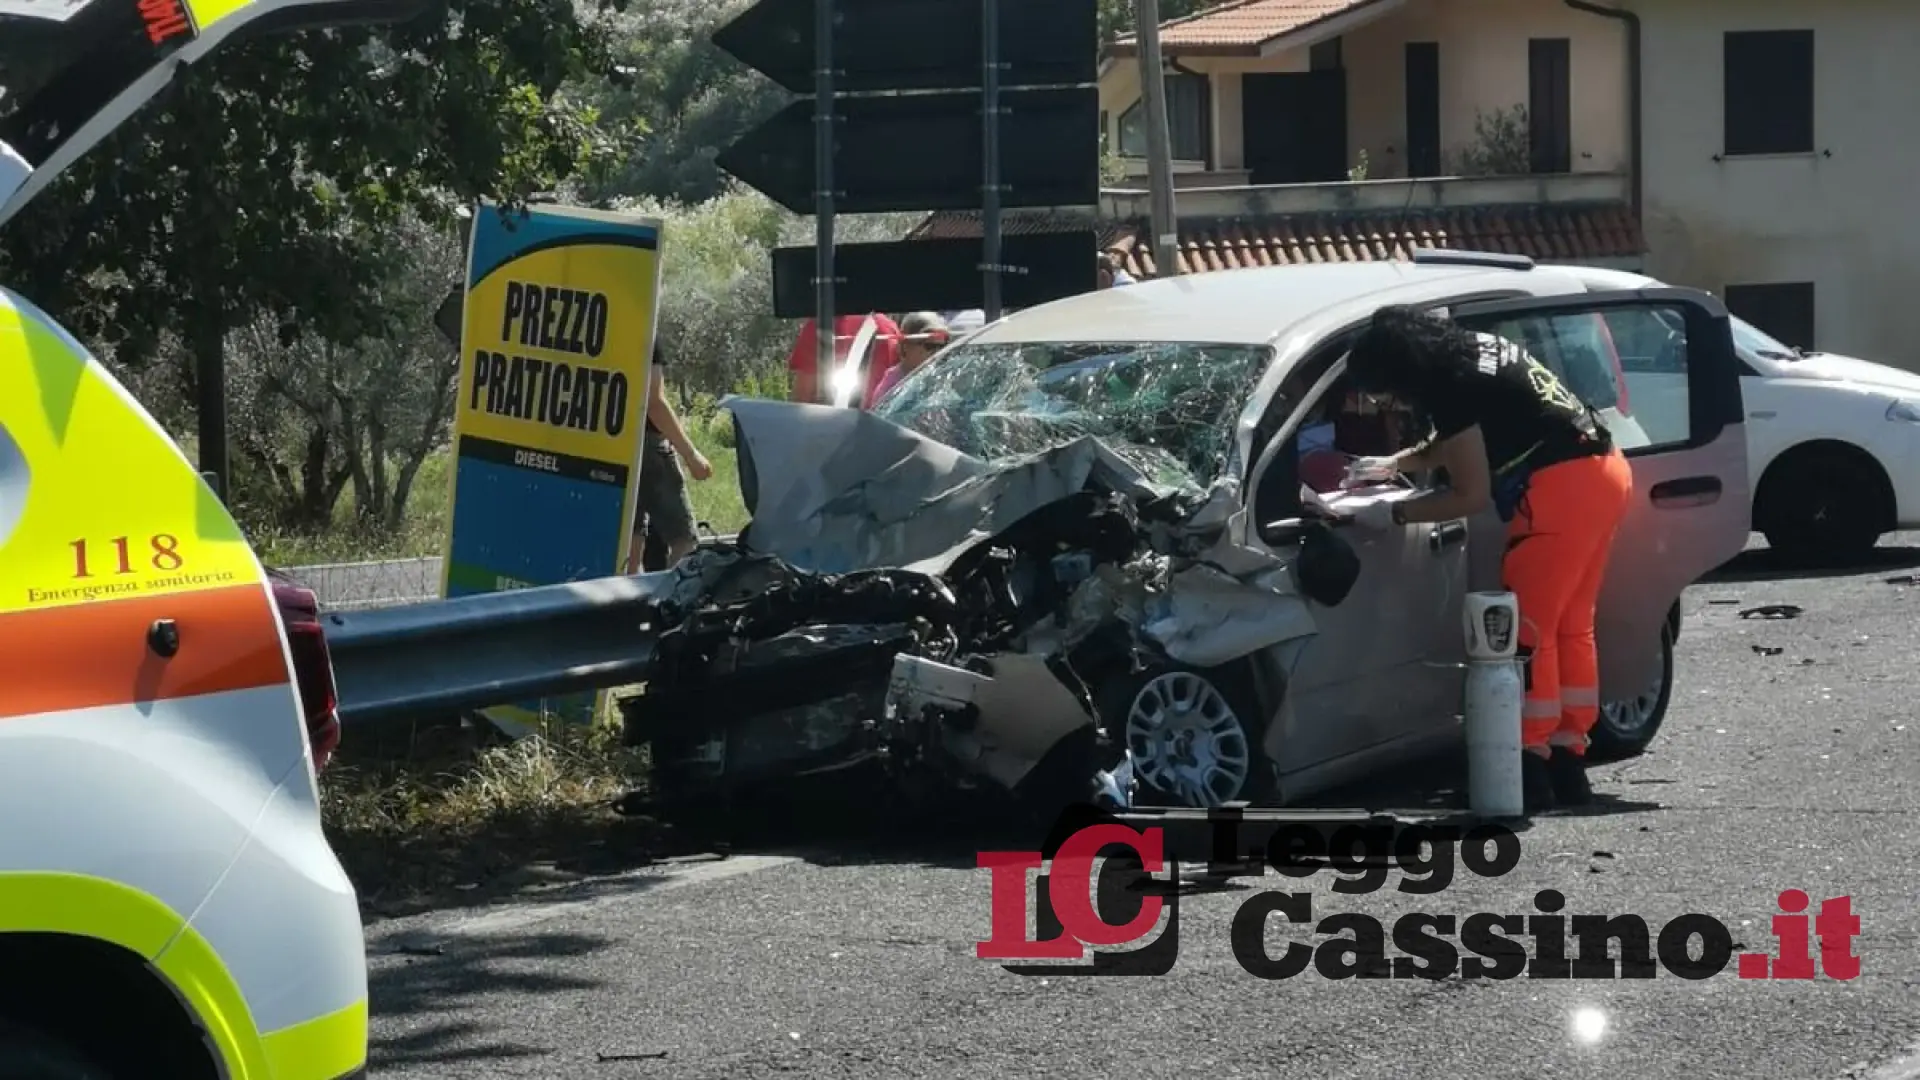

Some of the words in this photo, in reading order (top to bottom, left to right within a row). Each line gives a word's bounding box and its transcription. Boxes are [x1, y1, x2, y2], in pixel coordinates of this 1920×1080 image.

[503, 281, 608, 357] PREZZO
[471, 350, 628, 436] PRATICATO
[514, 450, 561, 473] DIESEL
[69, 534, 184, 578] 118
[28, 582, 139, 602] Emergenza
[146, 570, 234, 589] sanitaria
